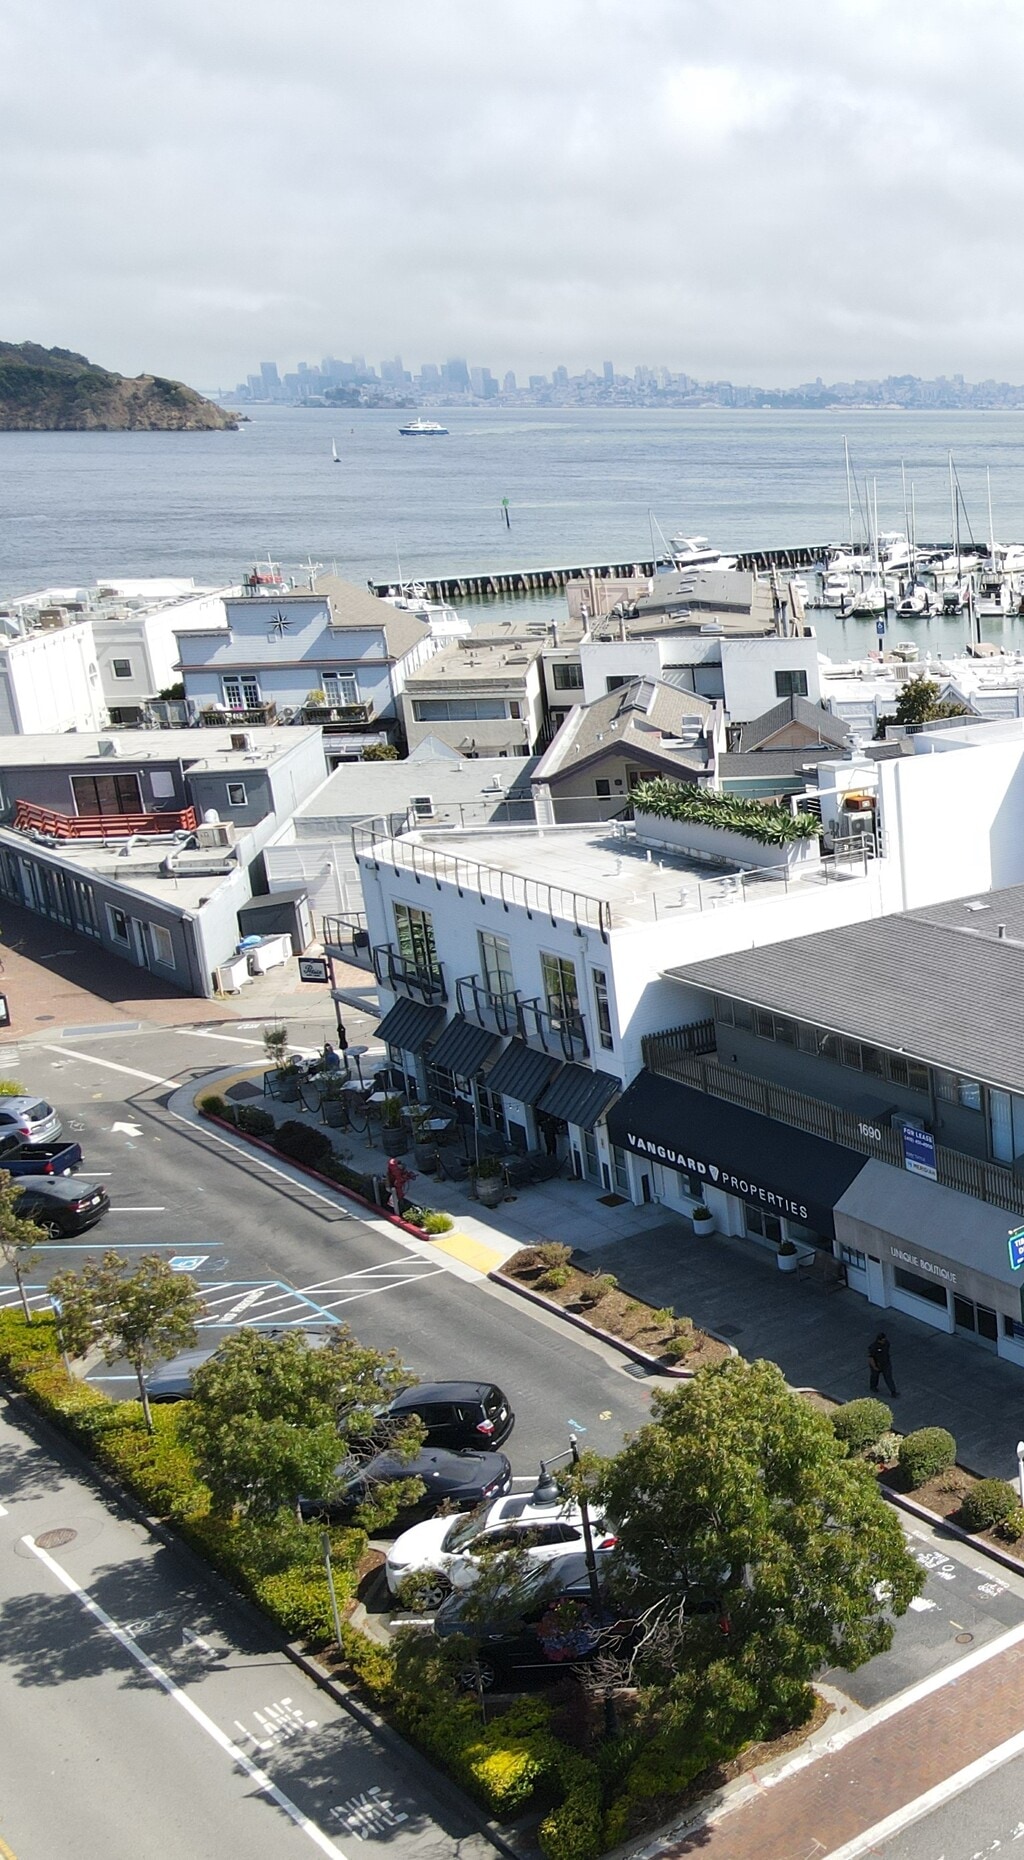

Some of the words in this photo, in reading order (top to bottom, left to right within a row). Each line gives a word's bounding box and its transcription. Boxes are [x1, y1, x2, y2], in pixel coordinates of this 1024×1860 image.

[857, 1122, 881, 1141] 1690
[903, 1127, 915, 1137] FOR
[915, 1128, 933, 1143] LEASE
[627, 1132, 706, 1175] VANGUARD
[721, 1172, 808, 1219] PROPERTIES
[890, 1246, 919, 1267] UNIQUE
[919, 1259, 957, 1284] BOUTIQUE
